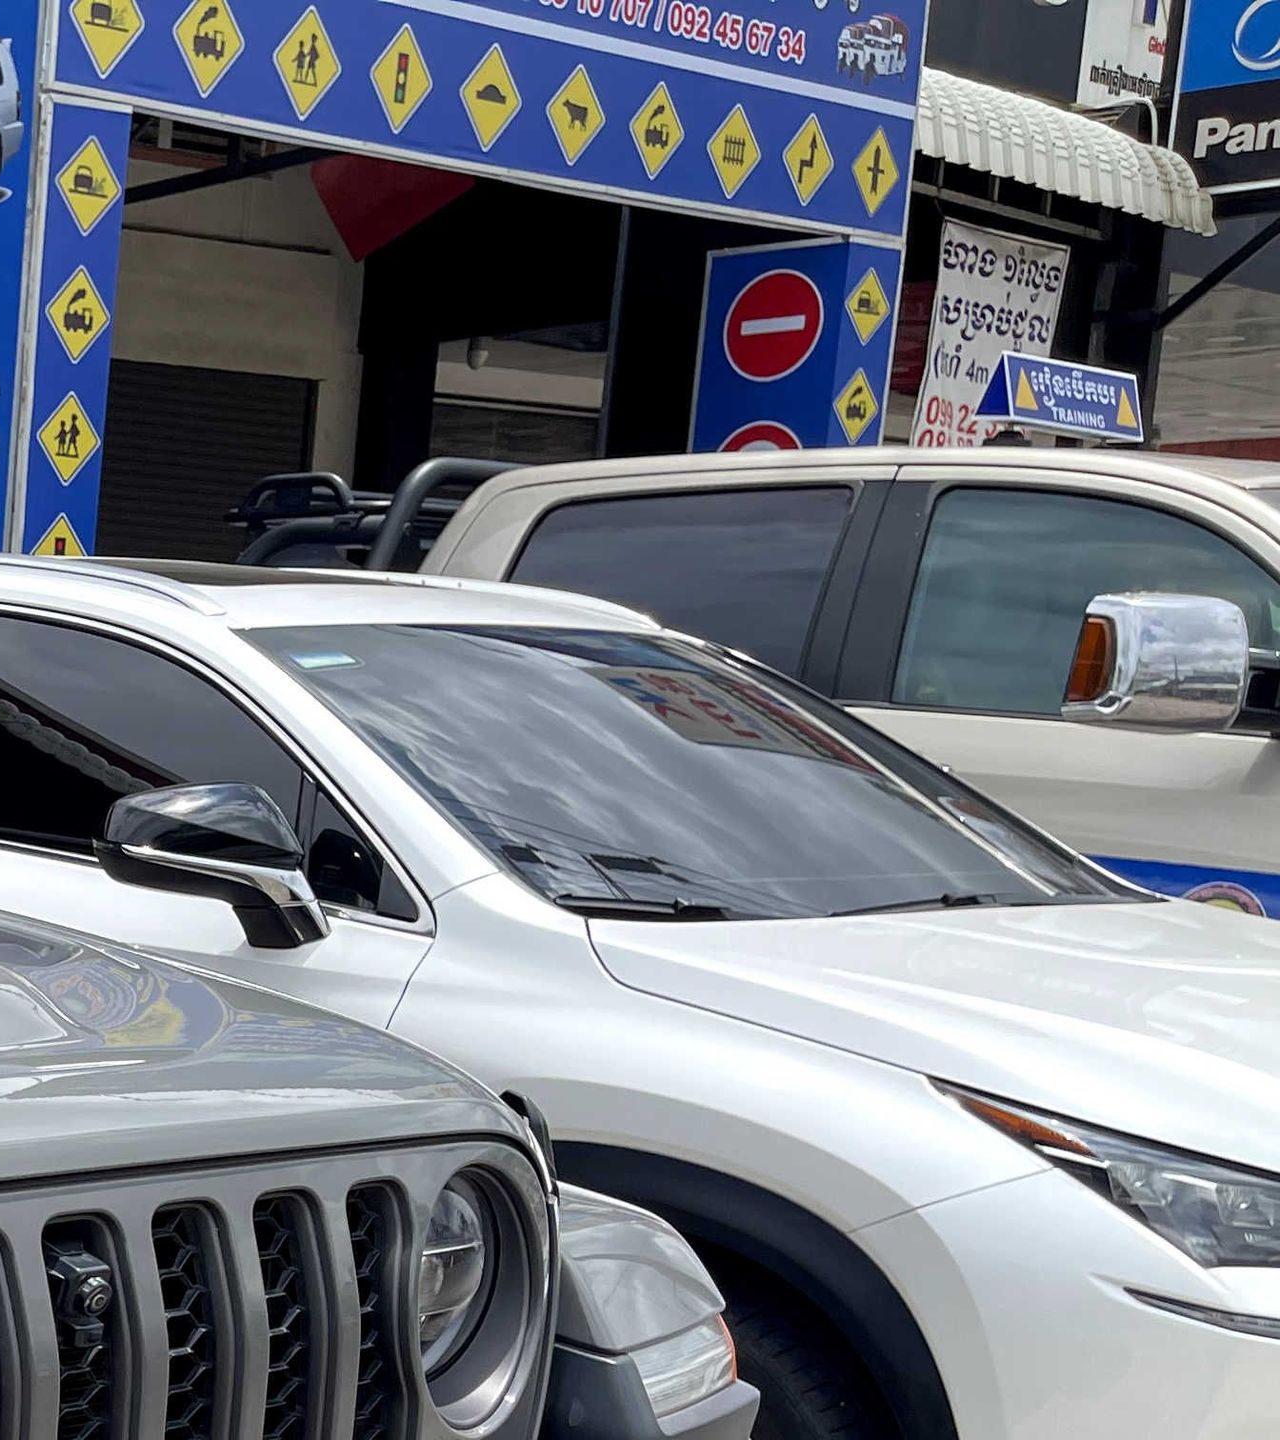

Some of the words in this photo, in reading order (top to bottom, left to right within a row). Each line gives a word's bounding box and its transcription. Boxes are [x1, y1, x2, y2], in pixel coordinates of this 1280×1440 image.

[609, 0, 651, 29] 707
[668, 5, 711, 40] 092
[714, 13, 743, 48] 45
[746, 19, 775, 56] 67
[778, 26, 806, 64] 34
[1030, 366, 1116, 407] រៀនបើកបរ
[1052, 406, 1106, 429] TRAINING
